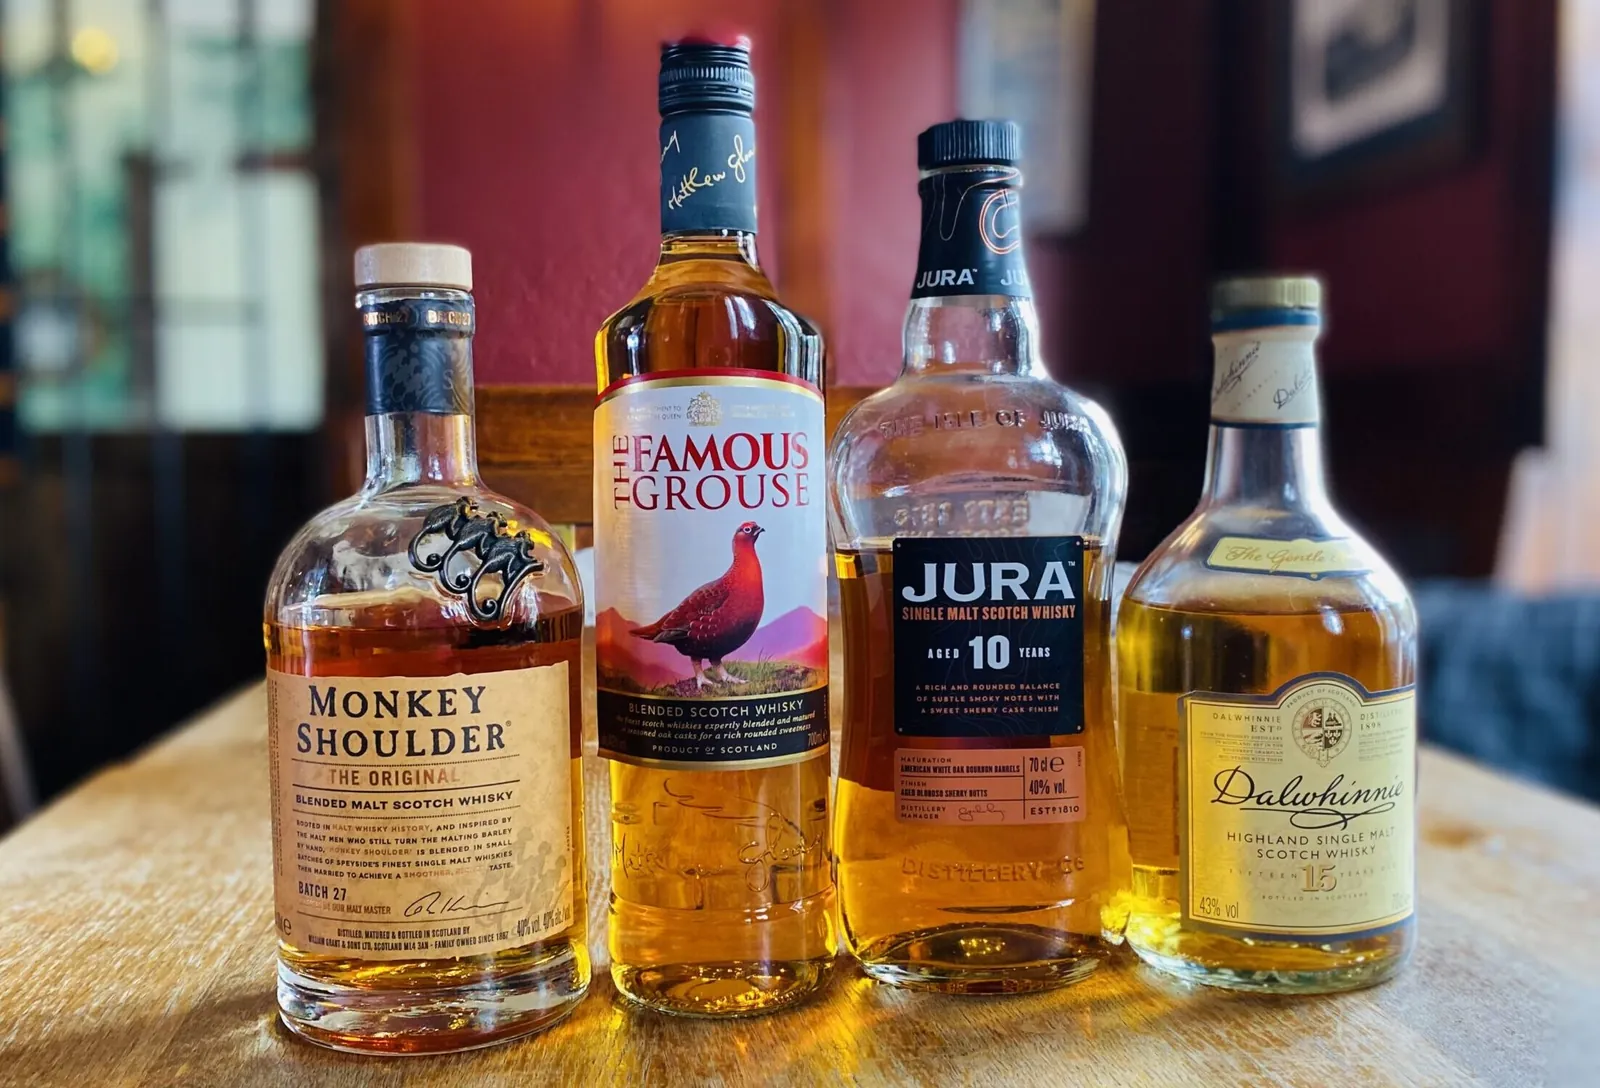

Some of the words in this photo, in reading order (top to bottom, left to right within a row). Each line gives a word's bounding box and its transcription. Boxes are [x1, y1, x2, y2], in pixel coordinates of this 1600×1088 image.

[934, 409, 984, 430] ISLE
[996, 409, 1028, 428] OF
[633, 431, 809, 473] FAMOUS
[613, 434, 630, 510] THE
[633, 472, 809, 511] GROUSE
[1225, 546, 1262, 563] The
[902, 606, 944, 621] SINGLE
[947, 606, 979, 621] MALT
[982, 606, 1028, 620] SCOTCH
[1032, 604, 1076, 620] WHISKY
[928, 648, 960, 659] AGED
[968, 634, 1010, 670] 10
[1019, 647, 1051, 658] YEARS
[308, 685, 486, 718] MONKEY
[629, 703, 684, 717] BLENDED
[690, 705, 749, 717] SCOTCH
[755, 699, 803, 716] WHISKY
[642, 719, 665, 728] scotch
[667, 721, 702, 729] whiskies
[704, 720, 740, 731] expertly
[743, 718, 775, 729] blended
[777, 715, 791, 725] and
[792, 710, 816, 723] matured
[1212, 712, 1281, 724] DALWHINNIE
[658, 730, 672, 739] oak
[674, 731, 697, 740] casks
[698, 731, 713, 741] for
[723, 731, 741, 739] rich
[744, 727, 777, 739] rounded
[779, 723, 811, 735] sweetness
[652, 744, 700, 754] PRODUCT
[705, 746, 716, 755] OF
[720, 743, 778, 754] SCOTLAND
[901, 765, 931, 773] AMERICAN
[932, 765, 951, 773] WHITE
[966, 765, 993, 773] BOURBON
[994, 765, 1020, 773] BARRELS
[1029, 757, 1039, 772] 70
[1040, 757, 1048, 772] cl
[330, 769, 359, 785] THE
[369, 768, 461, 787] ORIGINAL
[1029, 779, 1050, 795] 40%
[1053, 778, 1067, 794] vol.
[901, 788, 915, 797] AGED
[945, 789, 967, 797] SHERRY
[969, 789, 988, 797] BUTTS
[1211, 765, 1404, 809] Dalwhinnie
[296, 794, 347, 808] BLENDED
[351, 800, 388, 810] MALT
[393, 798, 453, 810] SCOTCH
[459, 791, 513, 806] WHISKY
[1059, 805, 1080, 814] 1810
[323, 823, 331, 831] IN
[391, 824, 433, 832] HISTORY,
[459, 819, 499, 829] INSPIRED
[502, 816, 512, 824] BY
[296, 831, 307, 839] THE
[310, 833, 326, 842] MALT
[441, 833, 478, 842] MALTING
[482, 828, 512, 838] BARLEY
[1227, 831, 1309, 845] HIGHLAND
[1317, 832, 1364, 845] SINGLE
[1370, 826, 1395, 842] MALT
[429, 846, 469, 855] BLENDED
[486, 840, 512, 849] SMALL
[1257, 848, 1320, 860] SCOTCH
[1326, 844, 1376, 859] WHISKY
[297, 853, 323, 864] BATCHES
[336, 860, 379, 868] SPEYSIDE'S
[415, 859, 446, 867] SINGLE
[450, 856, 471, 865] MALT
[475, 851, 513, 862] WHISKIES
[298, 865, 312, 873] THEN
[314, 867, 344, 878] MARRIED
[490, 862, 513, 871] TASTE.
[1301, 863, 1337, 892] 15
[298, 881, 329, 900] BATCH
[333, 887, 347, 901] 27
[332, 902, 345, 912] OUR
[346, 904, 362, 914] MALT
[364, 905, 391, 915] MASTER
[1199, 897, 1221, 917] 43%
[1226, 902, 1239, 919] vol
[365, 930, 390, 940] MATURED
[392, 931, 397, 939] &
[398, 929, 422, 940] BOTTLED
[424, 930, 430, 938] IN
[432, 926, 461, 938] SCOTLAND
[463, 926, 470, 934] BY
[517, 917, 530, 937] 40%
[374, 942, 401, 951] SCOTLAND
[434, 939, 456, 949] FAMILY
[456, 936, 477, 947] OWNED
[478, 933, 494, 943] SINCE
